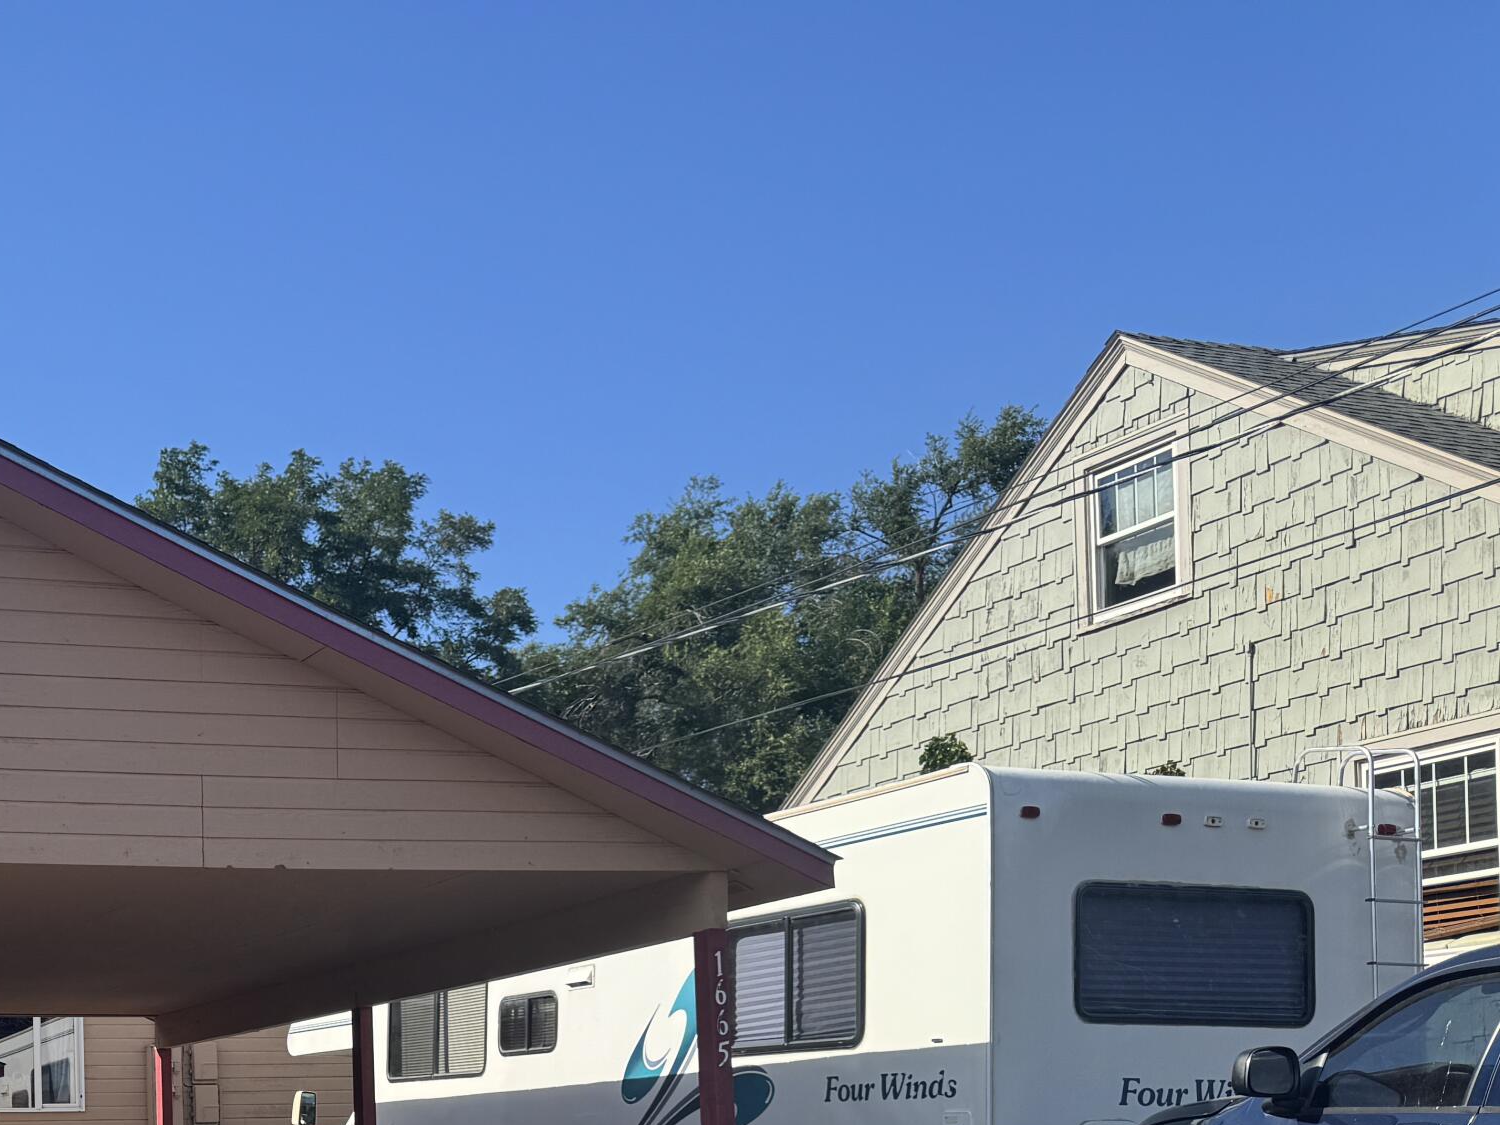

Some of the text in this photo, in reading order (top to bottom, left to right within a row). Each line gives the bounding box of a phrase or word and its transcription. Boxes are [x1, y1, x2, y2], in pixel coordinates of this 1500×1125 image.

[714, 950, 730, 1067] 1665
[824, 1069, 957, 1102] Four Winds
[1118, 1077, 1188, 1107] Four
